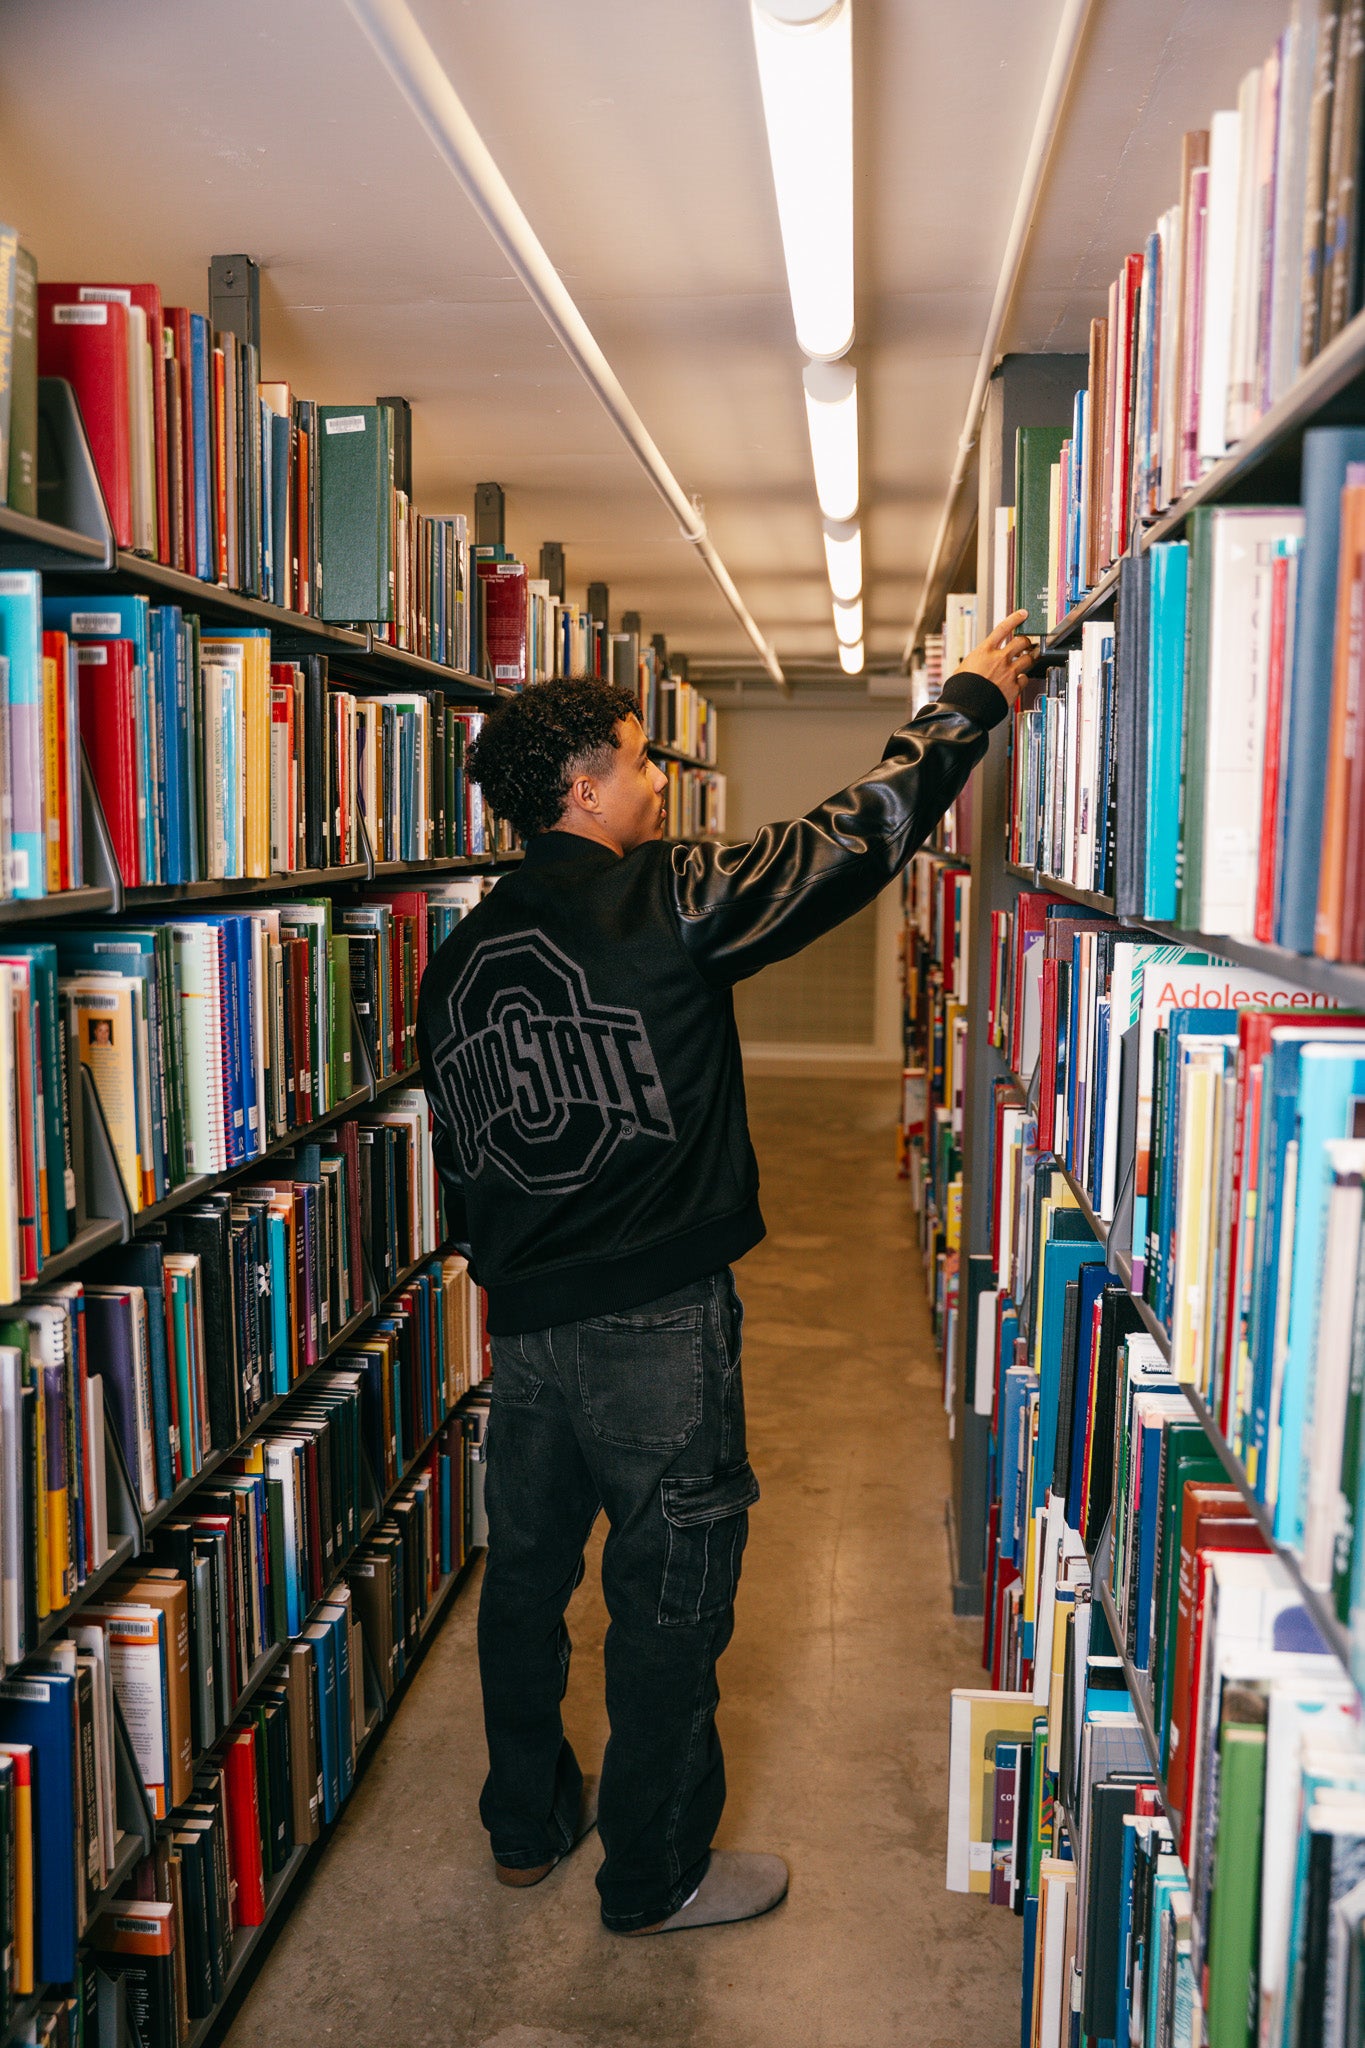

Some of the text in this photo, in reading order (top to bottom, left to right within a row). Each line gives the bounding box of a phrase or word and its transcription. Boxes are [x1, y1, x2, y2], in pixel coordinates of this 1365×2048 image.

[1156, 982, 1339, 1009] Adolescen
[438, 1022, 516, 1174] OHIO
[502, 1004, 673, 1137] STATE
[63, 1126, 72, 1170] READIN
